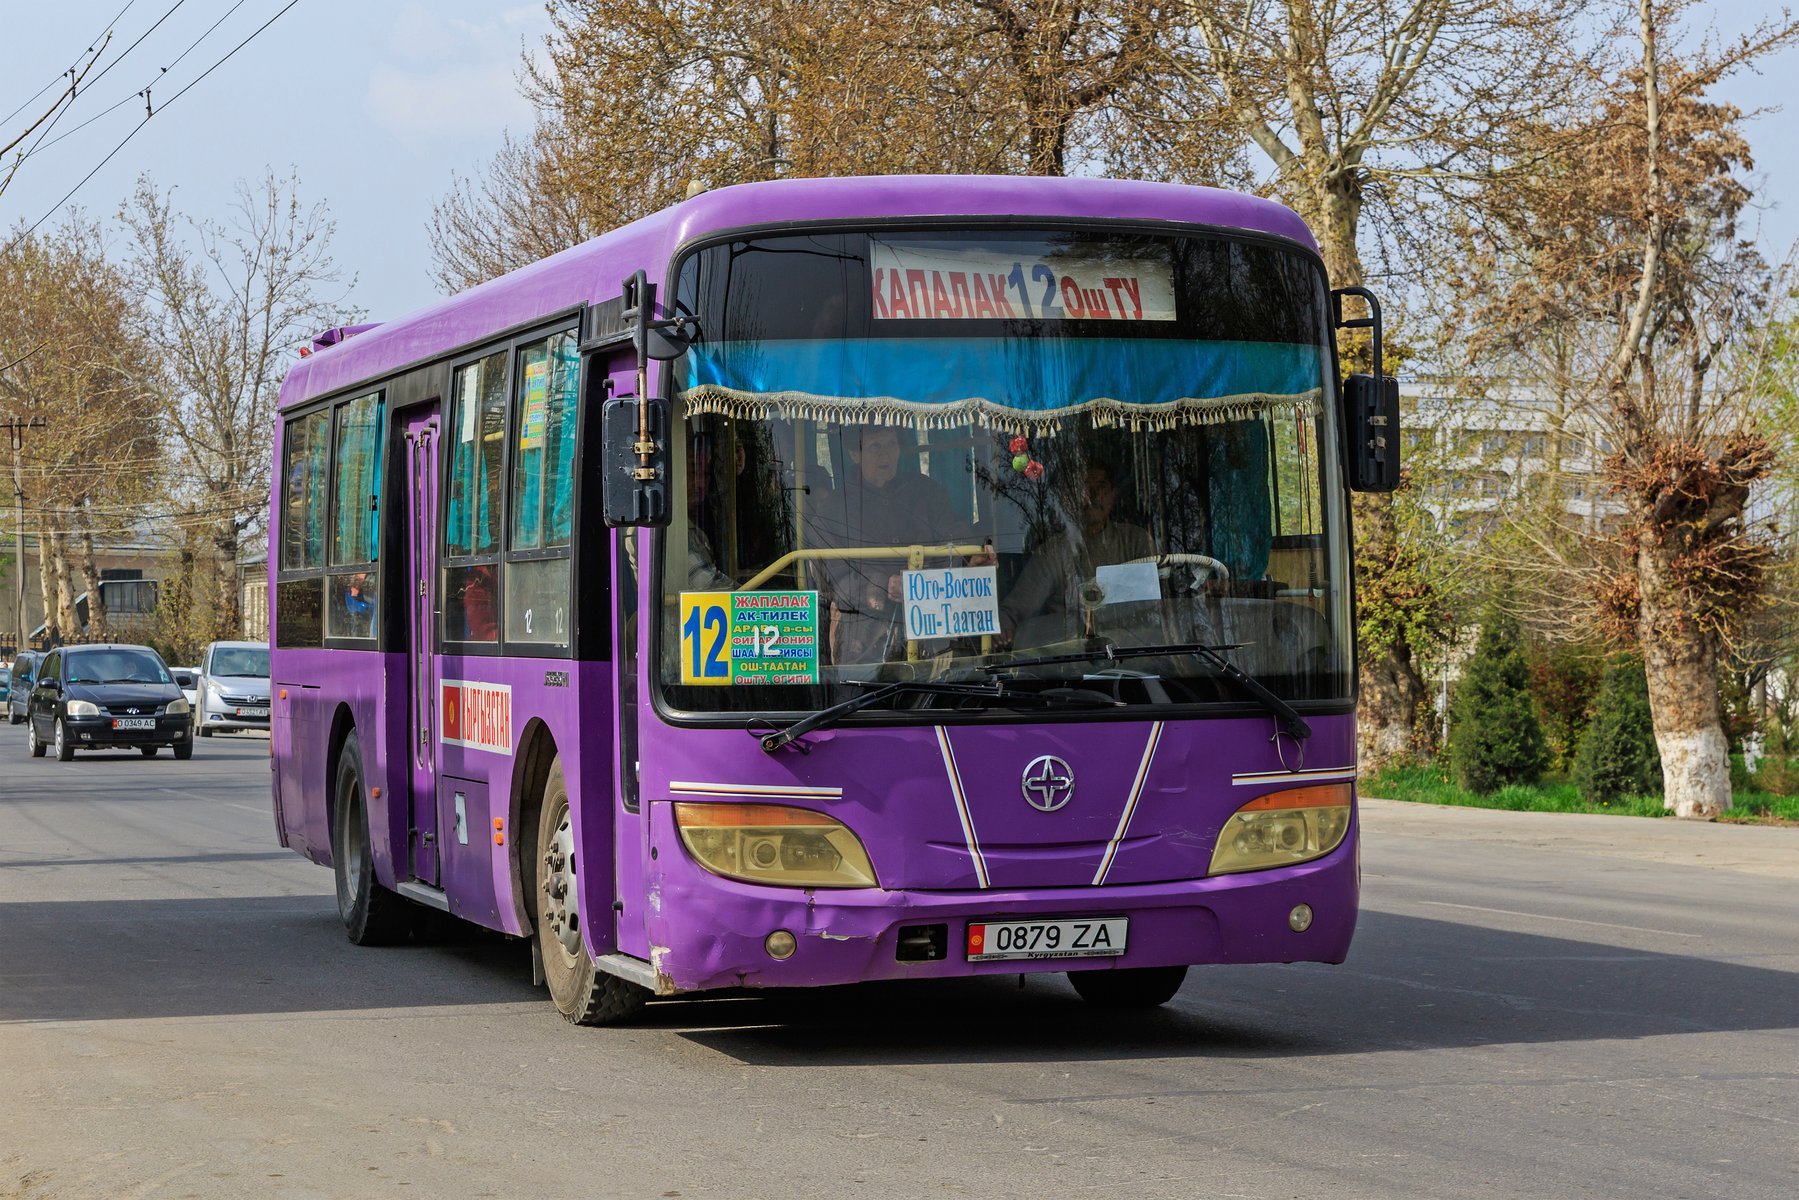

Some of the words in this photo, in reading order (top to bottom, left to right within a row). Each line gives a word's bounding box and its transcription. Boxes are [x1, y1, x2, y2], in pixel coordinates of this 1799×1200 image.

[1008, 262, 1065, 319] 12
[908, 571, 992, 601] Юго-Восток
[735, 596, 810, 608] ЖАПАЛАК
[525, 609, 532, 633] 12
[555, 607, 563, 634] 12
[736, 611, 809, 621] АК-ТИЛЕК
[910, 602, 995, 637] Ош-Таатан
[684, 605, 729, 678] 12
[732, 649, 758, 658] ШАА
[753, 625, 780, 656] 12
[740, 661, 807, 671] ОШ-ТААТАН
[773, 675, 812, 684] ОГИПИ
[462, 686, 510, 749] КЫРГЫЗСТАН
[996, 925, 1061, 951] 0879
[1071, 923, 1111, 949] ZA
[1027, 951, 1079, 959] Kyrgyzstan
